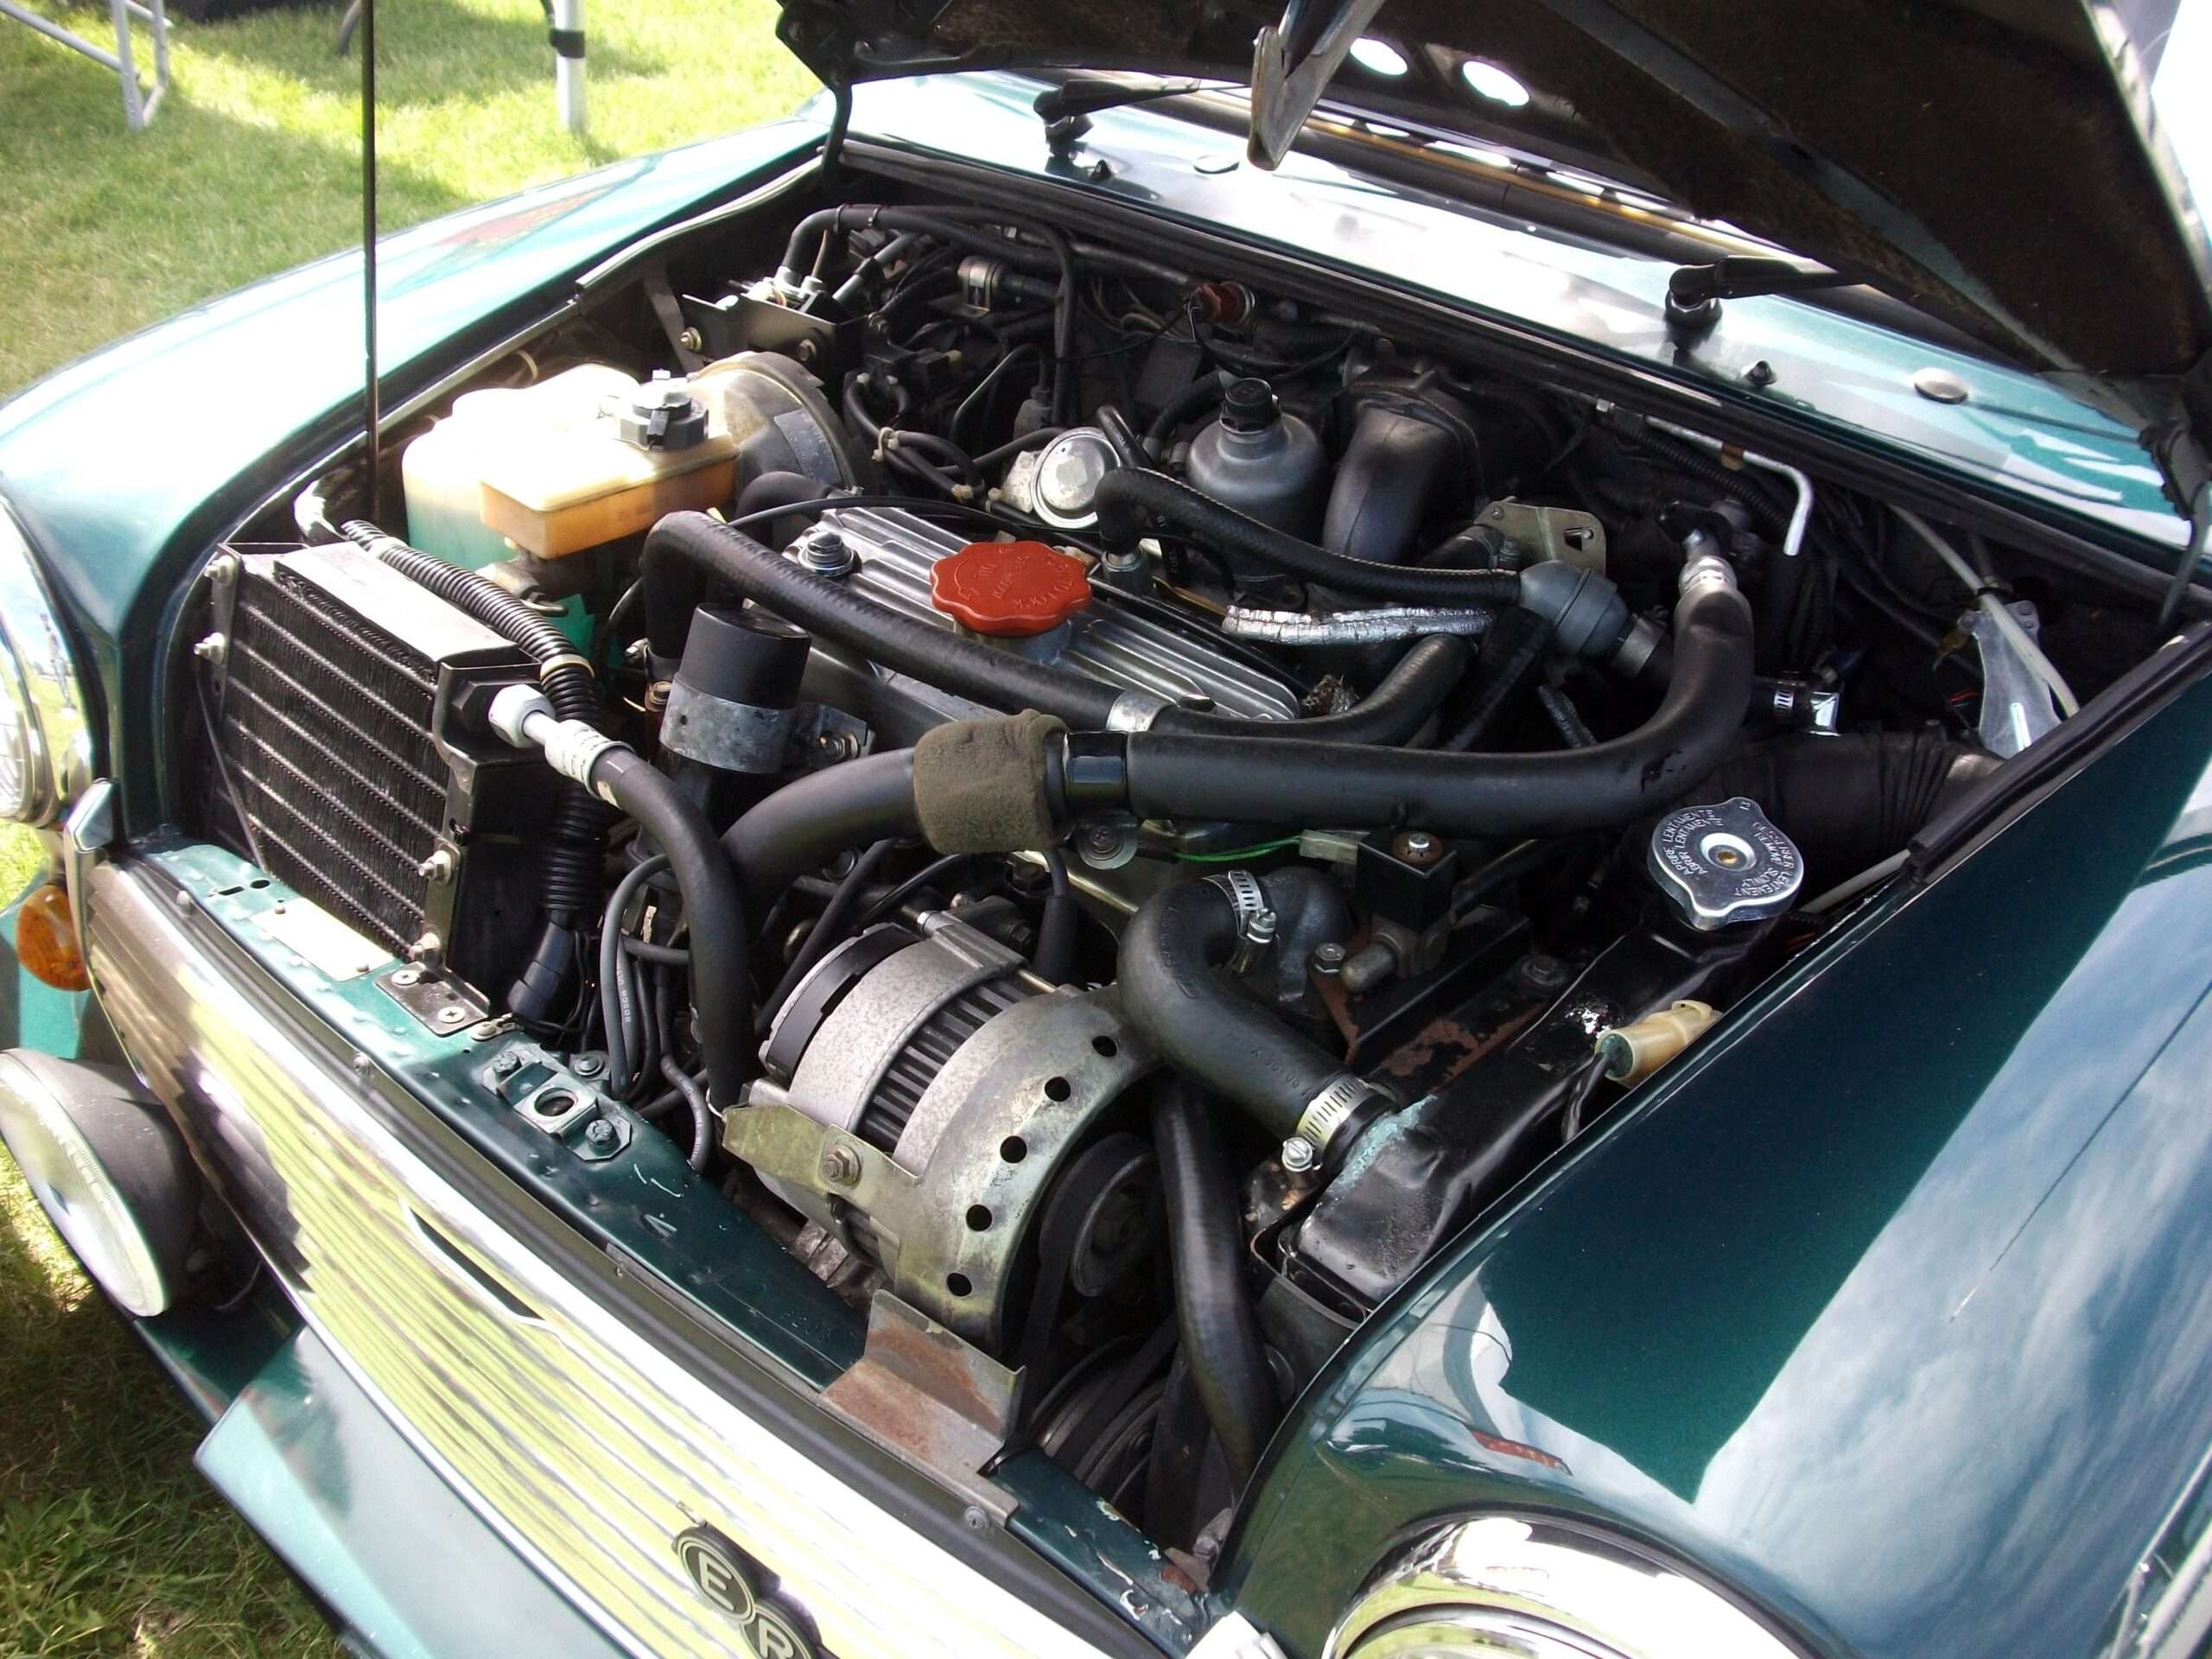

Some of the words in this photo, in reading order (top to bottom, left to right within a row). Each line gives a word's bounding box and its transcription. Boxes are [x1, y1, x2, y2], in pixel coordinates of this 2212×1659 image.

[1663, 846, 1694, 875] APRIRE
[1678, 849, 1708, 875] ABRIR
[1742, 867, 1778, 887] SLOWLY
